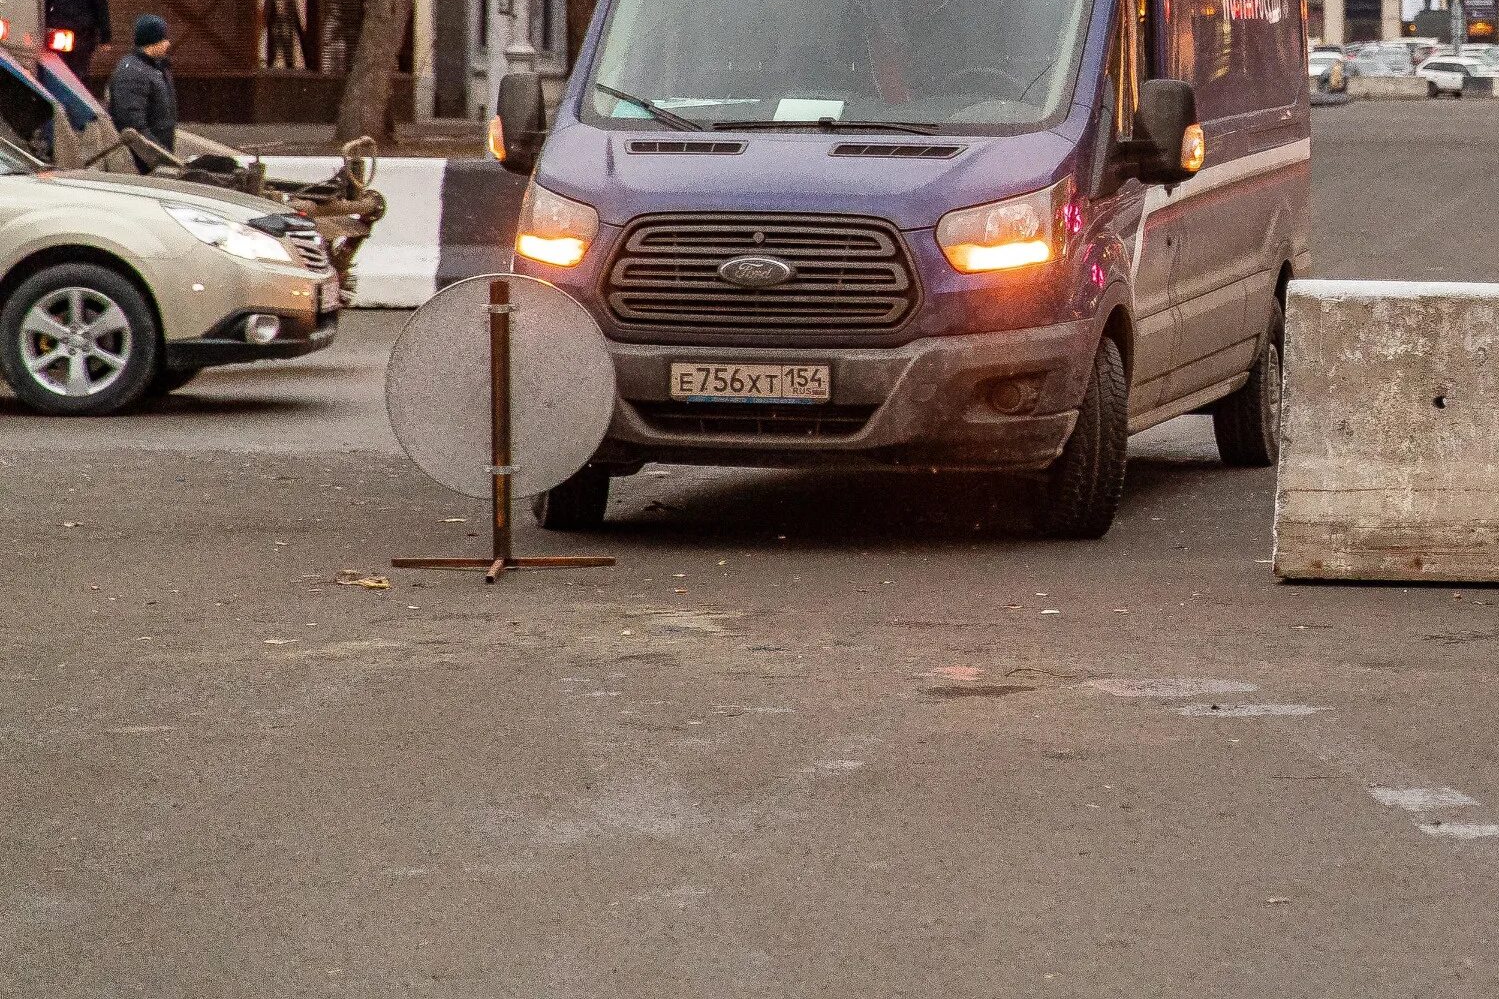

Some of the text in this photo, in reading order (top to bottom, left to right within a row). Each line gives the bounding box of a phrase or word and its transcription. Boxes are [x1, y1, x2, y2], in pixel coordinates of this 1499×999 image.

[735, 262, 774, 279] Ford
[784, 367, 823, 388] 154
[792, 386, 811, 396] RUS
